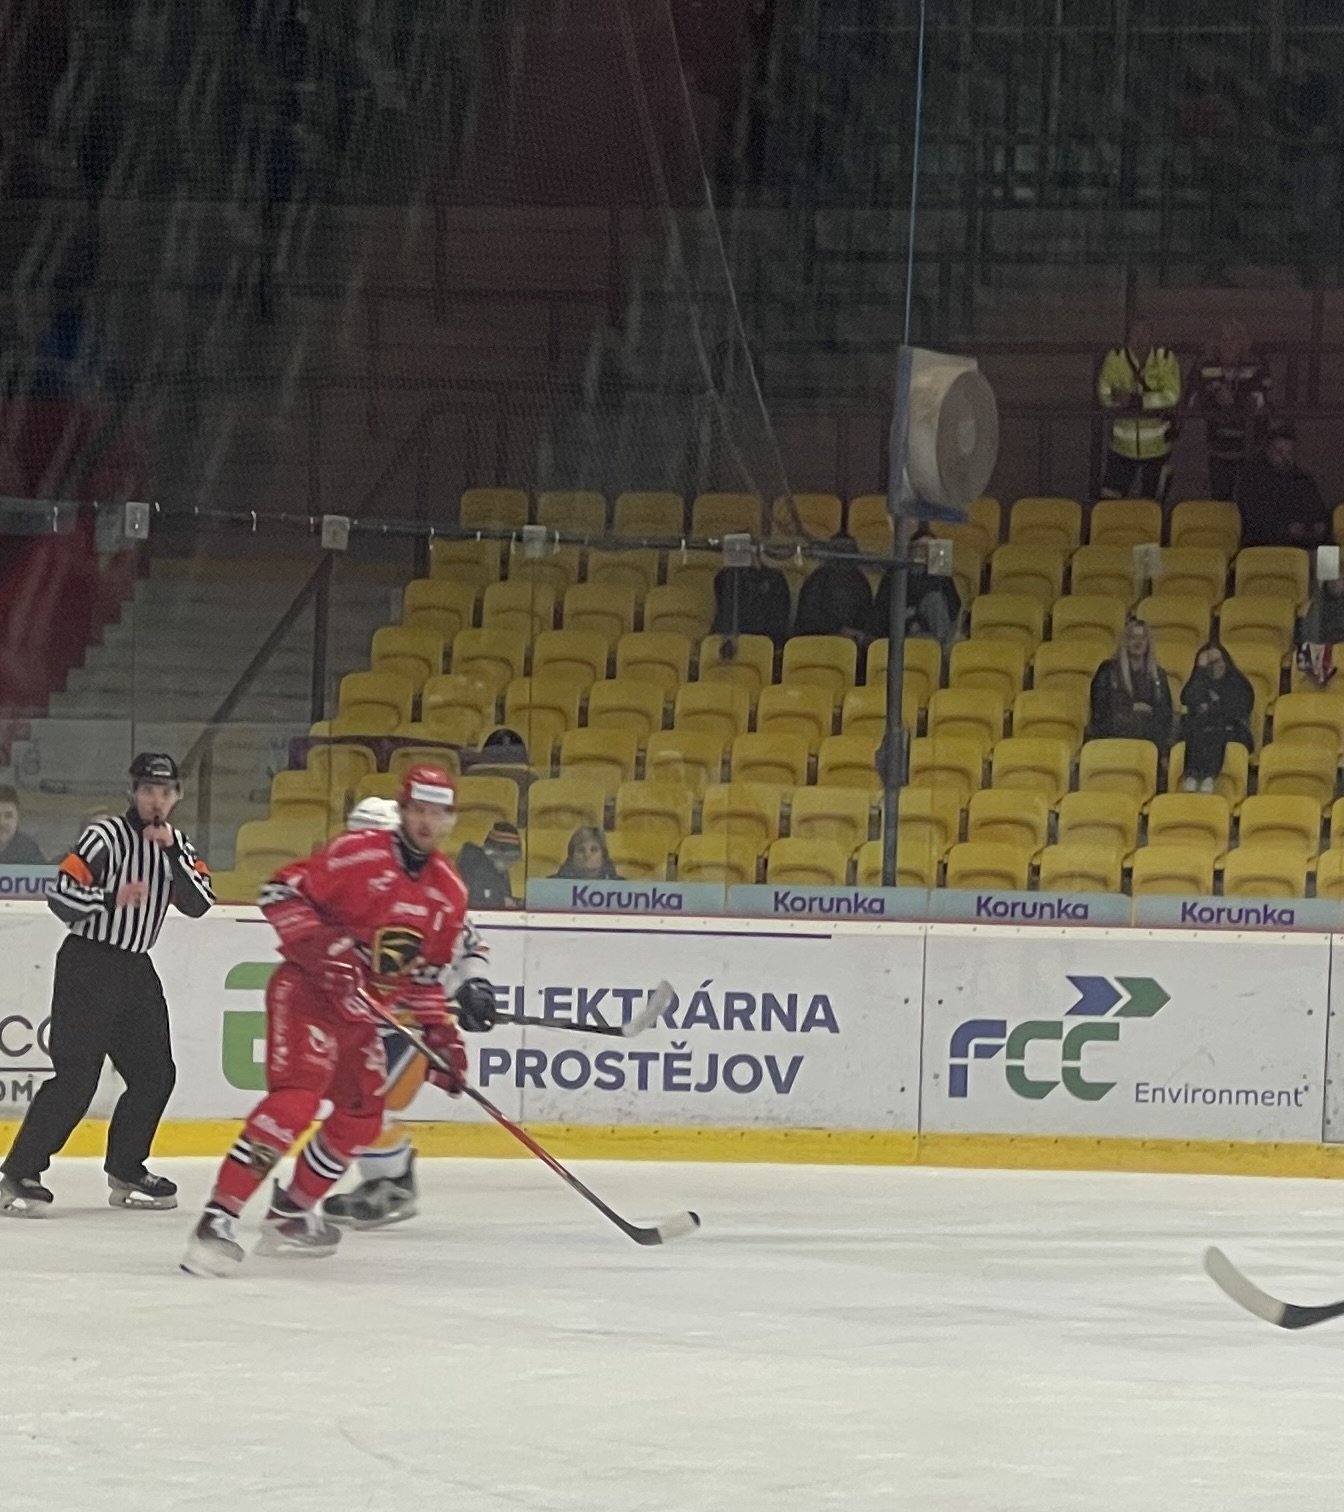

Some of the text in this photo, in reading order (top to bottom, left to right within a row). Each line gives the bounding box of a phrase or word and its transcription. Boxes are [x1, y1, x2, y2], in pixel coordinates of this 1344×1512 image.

[571, 885, 684, 911] Korunka
[773, 890, 886, 915] Korunka
[975, 895, 1089, 920] Korunka
[1181, 901, 1295, 926] Korunka
[478, 1040, 805, 1095] PROSTĚJOV
[948, 1019, 1120, 1101] FCC
[1134, 1081, 1304, 1108] Environment
